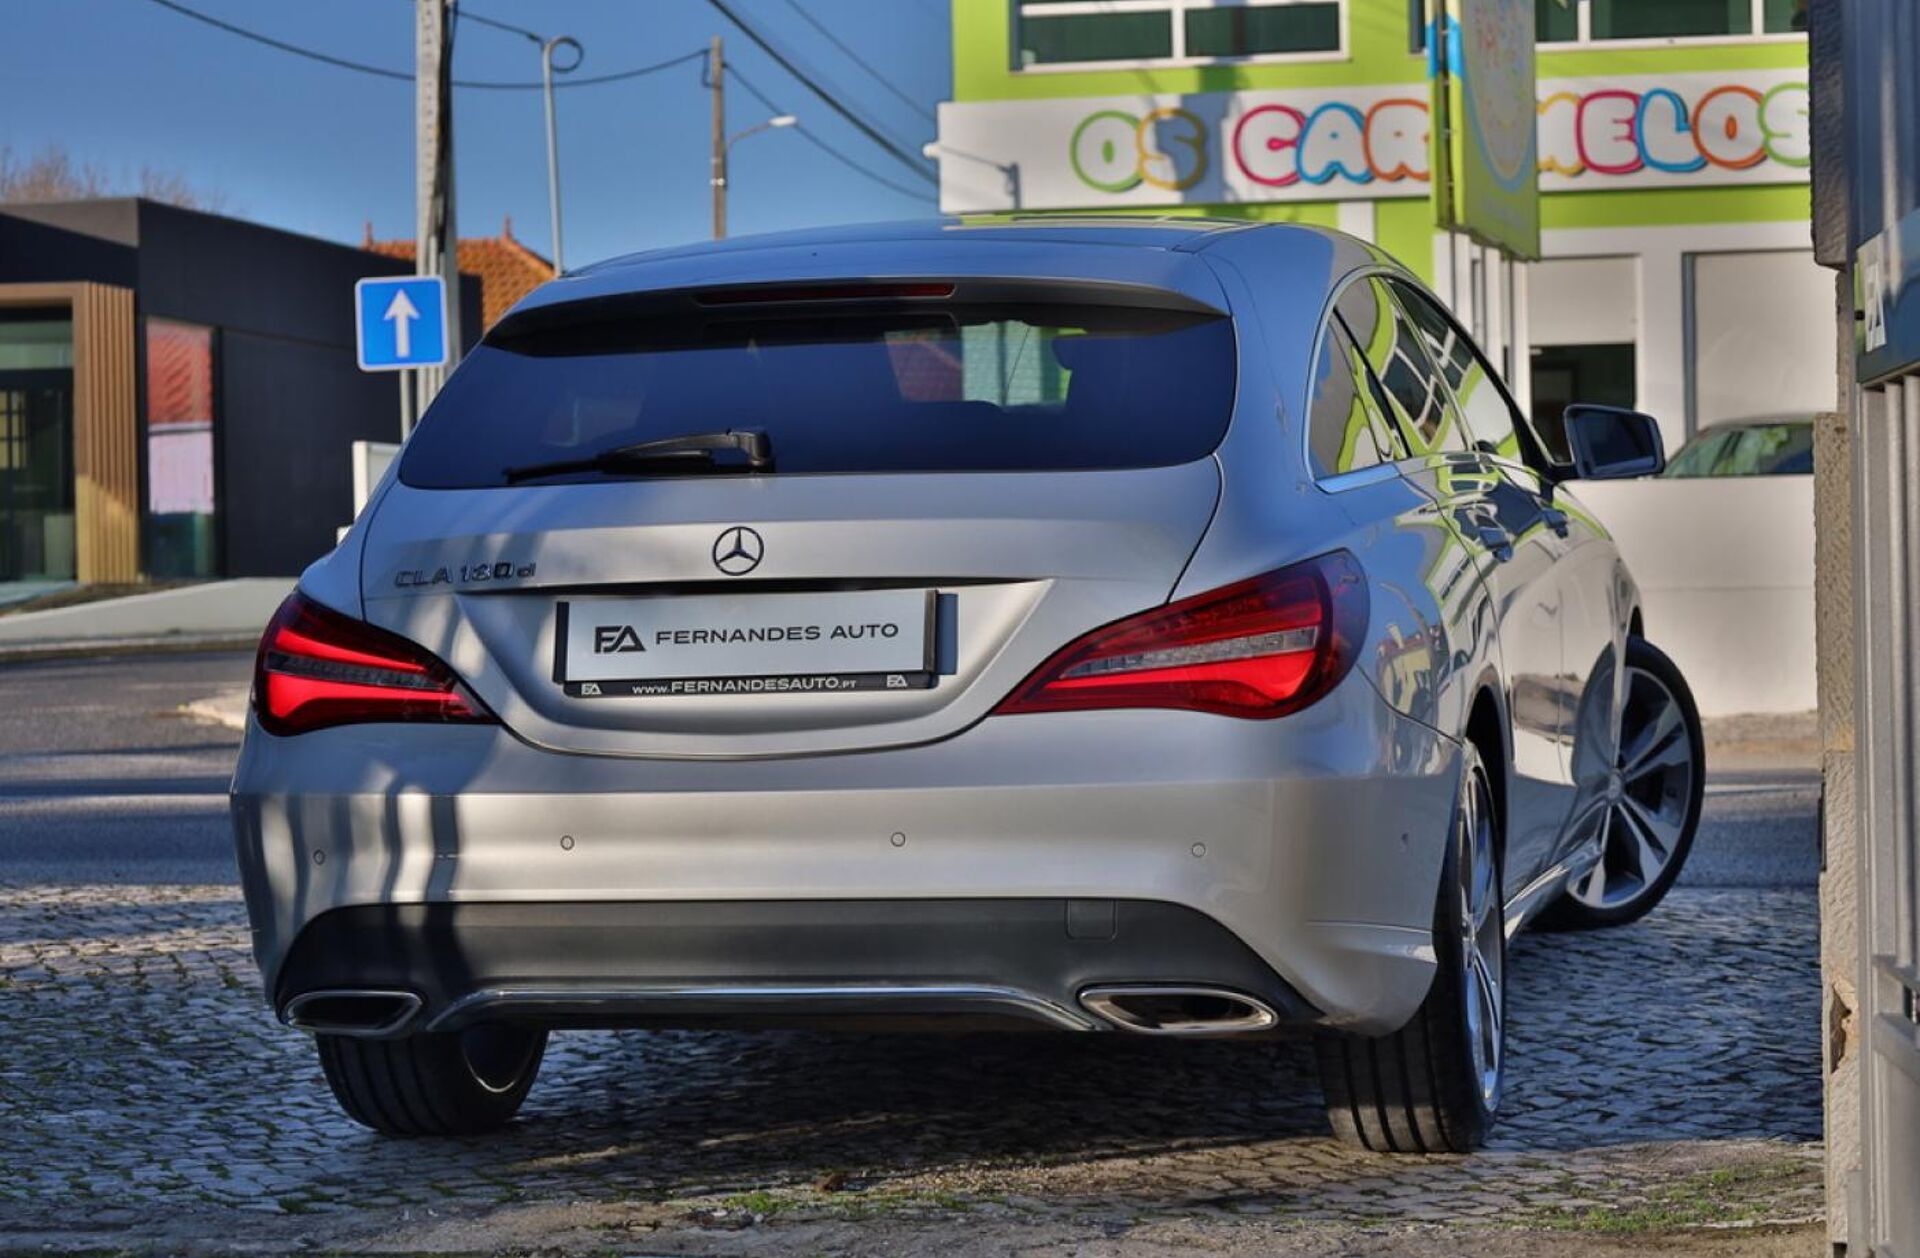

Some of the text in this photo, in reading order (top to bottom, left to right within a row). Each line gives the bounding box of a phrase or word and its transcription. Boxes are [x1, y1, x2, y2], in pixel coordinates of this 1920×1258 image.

[1070, 83, 1809, 193] OS CARMELOS
[395, 568, 451, 588] CLA
[594, 623, 899, 653] FA FERNANDES AUTO
